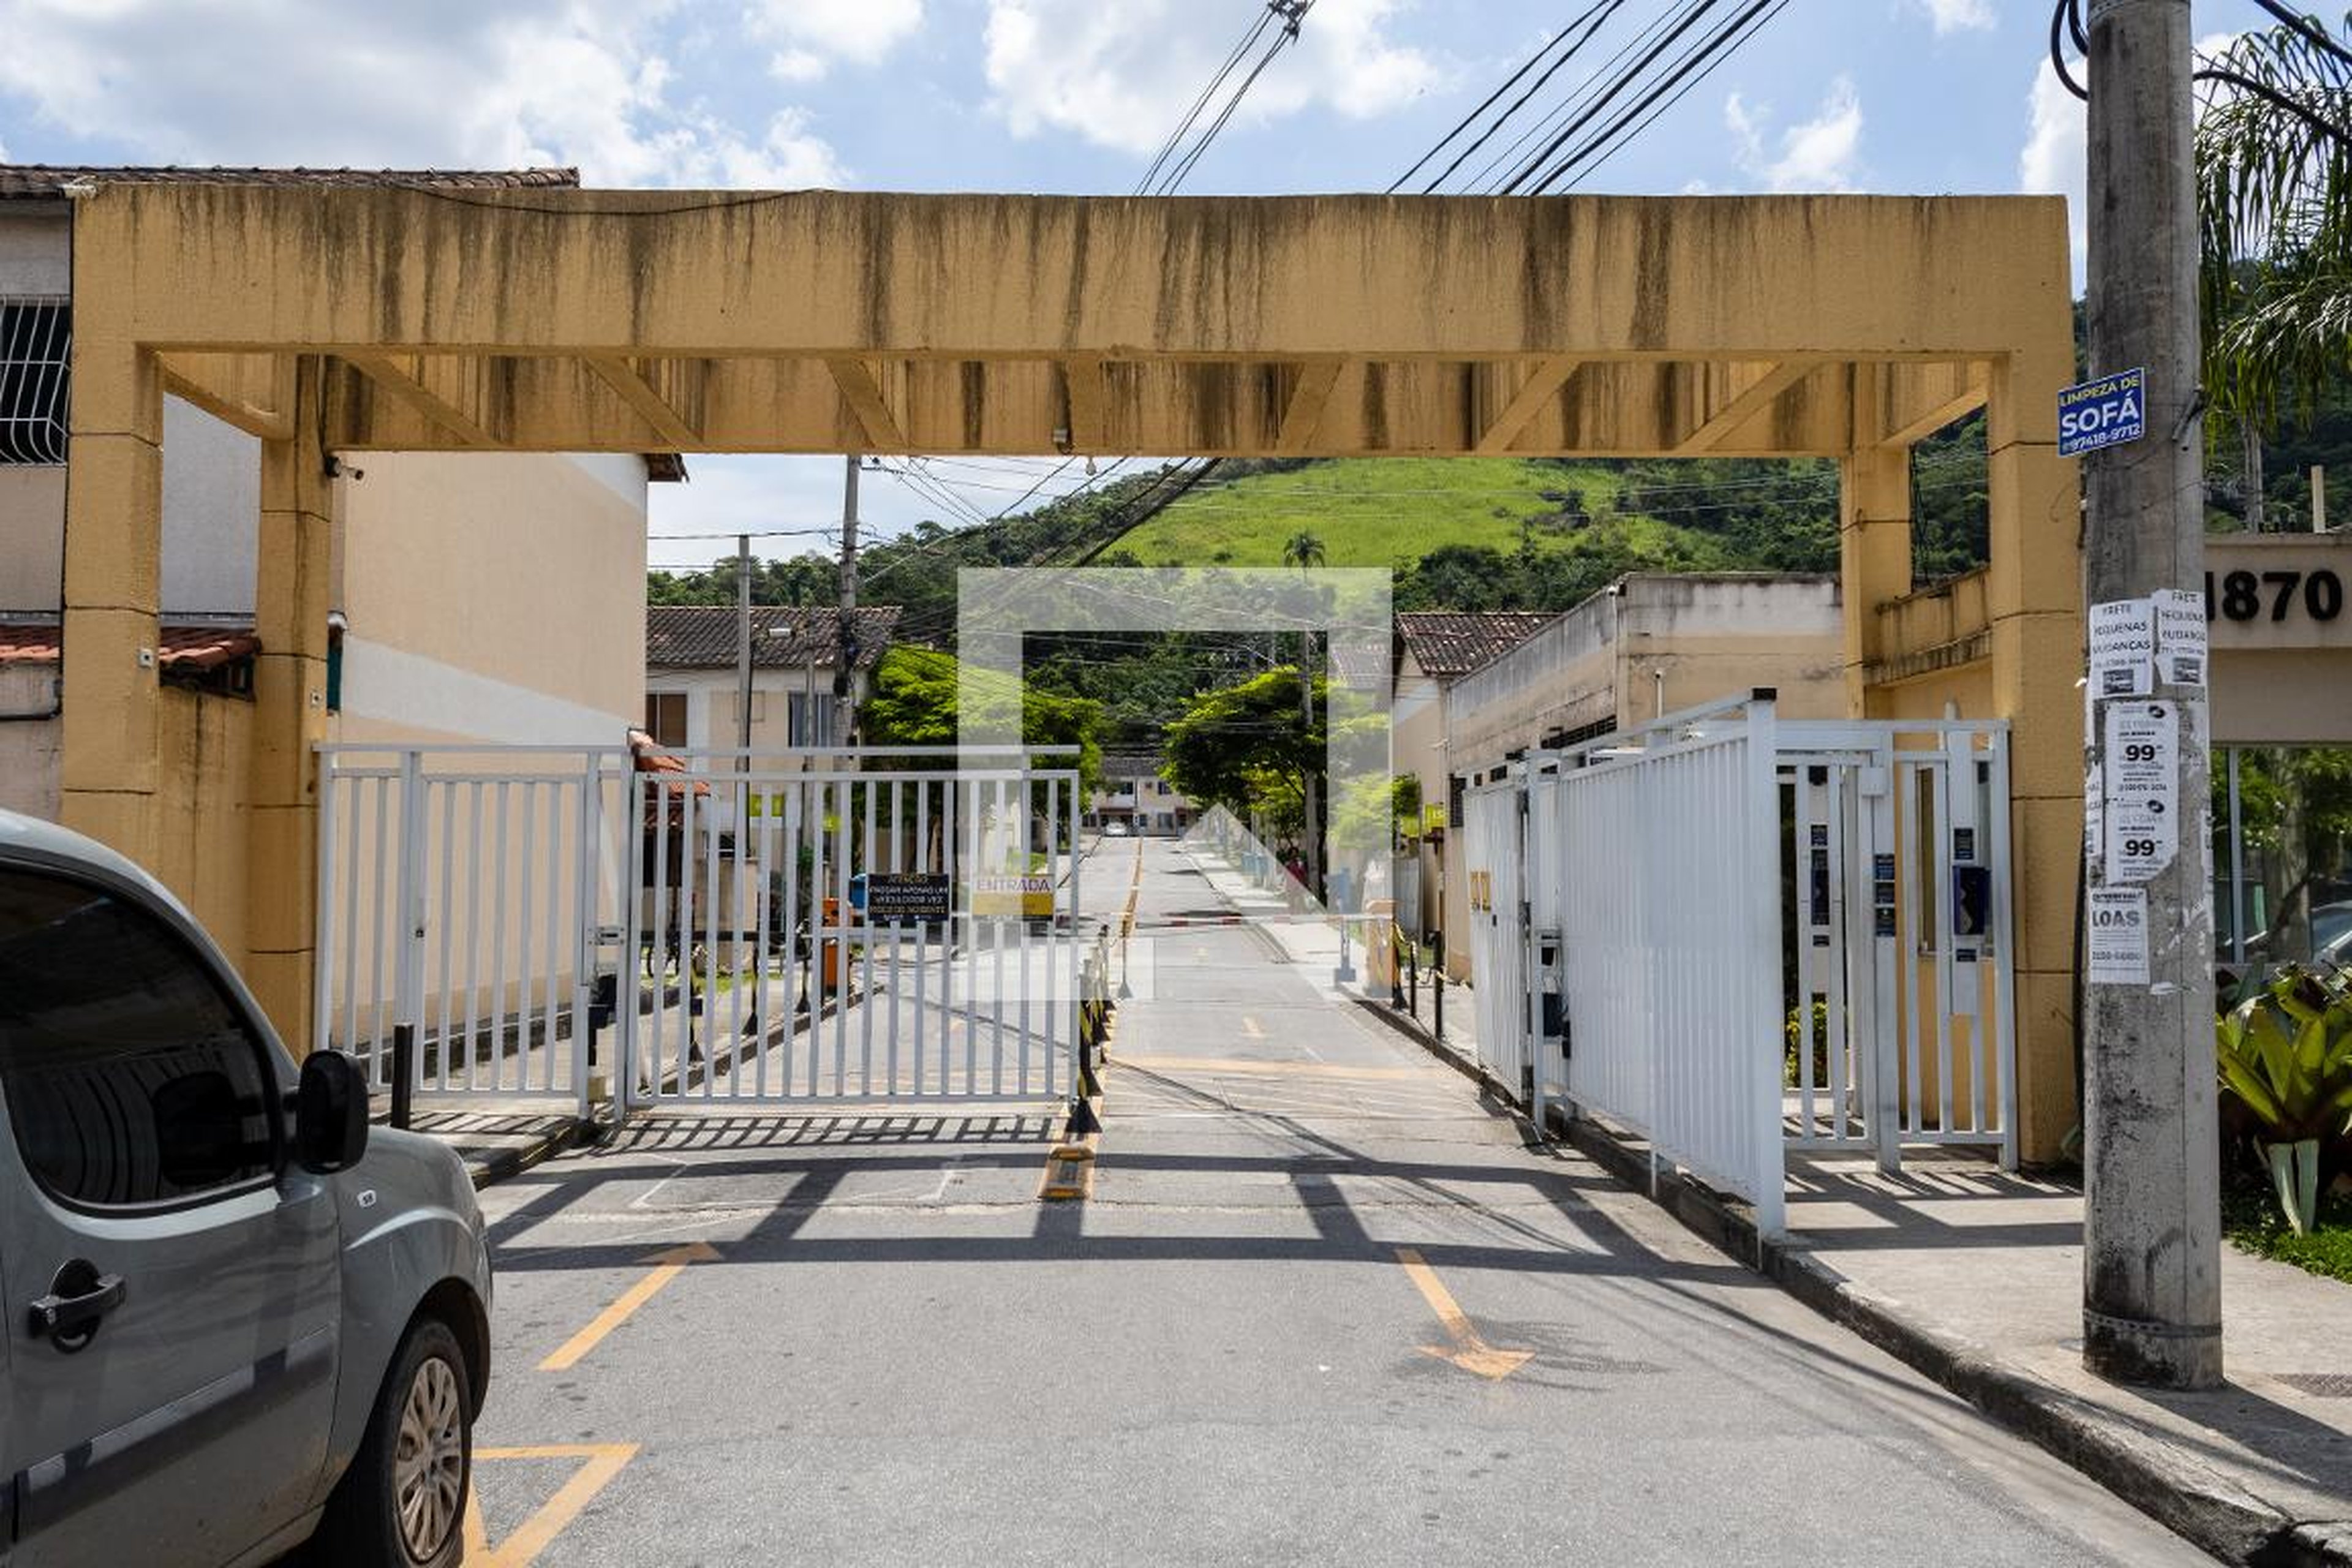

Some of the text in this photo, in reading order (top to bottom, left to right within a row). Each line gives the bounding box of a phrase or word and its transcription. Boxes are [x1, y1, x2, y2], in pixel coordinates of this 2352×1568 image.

[2059, 375, 2139, 406] LIMPEZA DE
[2062, 390, 2139, 437] SOFÁ
[2205, 571, 2342, 621] 1870
[2126, 745, 2155, 761] 99
[2125, 840, 2155, 856] 99
[978, 878, 1050, 891] ENTRADA
